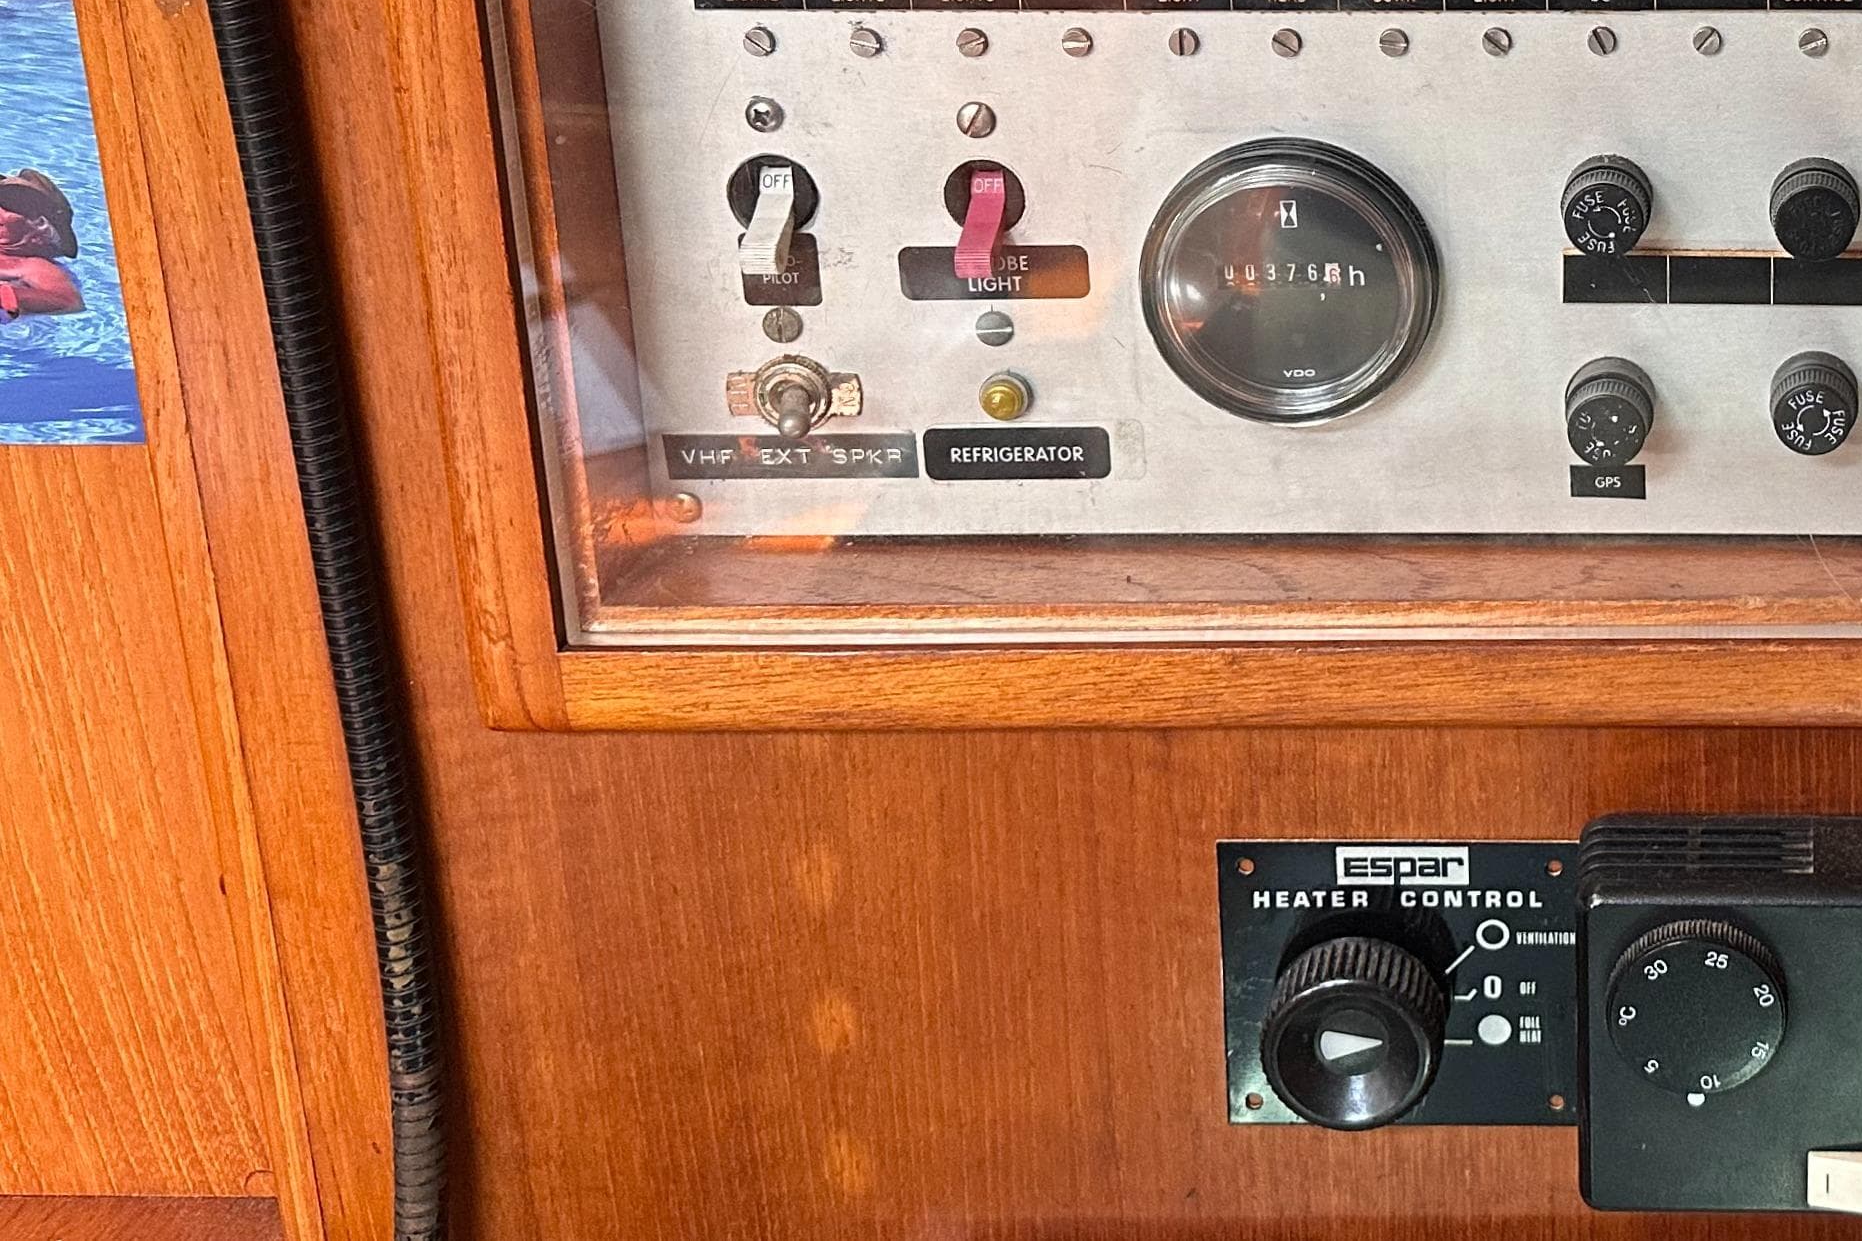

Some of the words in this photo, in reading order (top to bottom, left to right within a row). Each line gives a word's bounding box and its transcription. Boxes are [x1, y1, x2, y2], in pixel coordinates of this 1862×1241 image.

[762, 174, 790, 189] OFF
[974, 178, 1004, 195] OFF
[1572, 190, 1605, 219] FUSE
[1577, 231, 1615, 254] FUSE
[763, 272, 800, 285] PILOT
[968, 276, 1022, 292] LIGHT
[1349, 265, 1366, 286] h
[1283, 369, 1316, 378] VDO
[1788, 390, 1825, 410] FUSE
[1781, 421, 1812, 451] FUSE
[1824, 410, 1847, 445] FUSE
[682, 449, 735, 464] VHF
[760, 448, 811, 465] EXT
[833, 449, 902, 464] SPKR
[950, 446, 1084, 462] REFRIGERATOR
[1595, 477, 1621, 488] GPS
[1252, 890, 1369, 909] HEATER
[1400, 890, 1543, 908] CONTROL
[1516, 931, 1576, 946] VENTILATION
[1705, 951, 1729, 969] 25
[1643, 959, 1668, 981] 30
[1520, 981, 1536, 995] OFF
[1753, 984, 1775, 1007] 20
[1519, 1030, 1541, 1043] HEAT
[1751, 1041, 1770, 1059] 15
[1644, 1060, 1659, 1074] 5
[1700, 1074, 1721, 1090] 10
